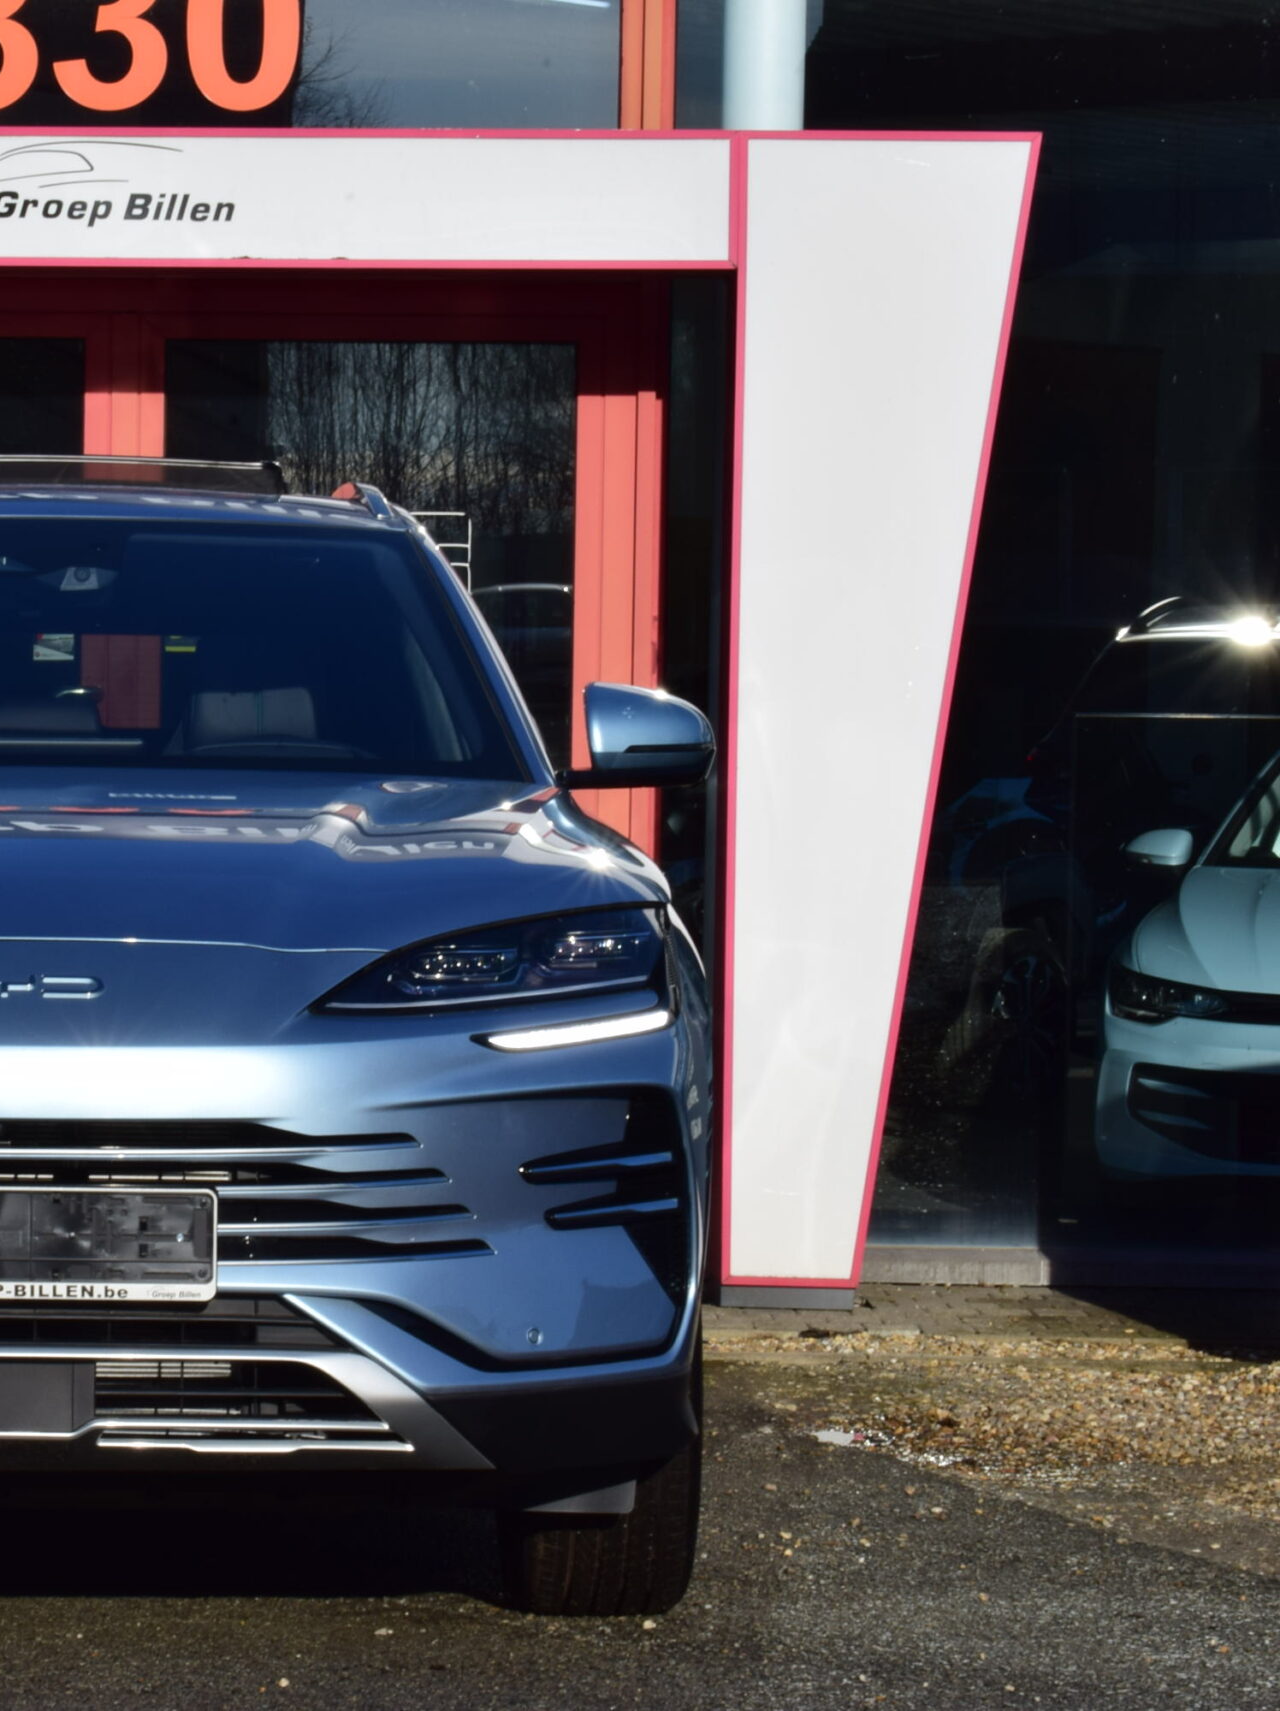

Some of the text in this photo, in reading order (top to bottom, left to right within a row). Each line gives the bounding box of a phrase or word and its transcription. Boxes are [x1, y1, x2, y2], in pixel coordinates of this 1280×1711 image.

[123, 193, 235, 222] Billen
[152, 1290, 201, 1299] Groep Billen
